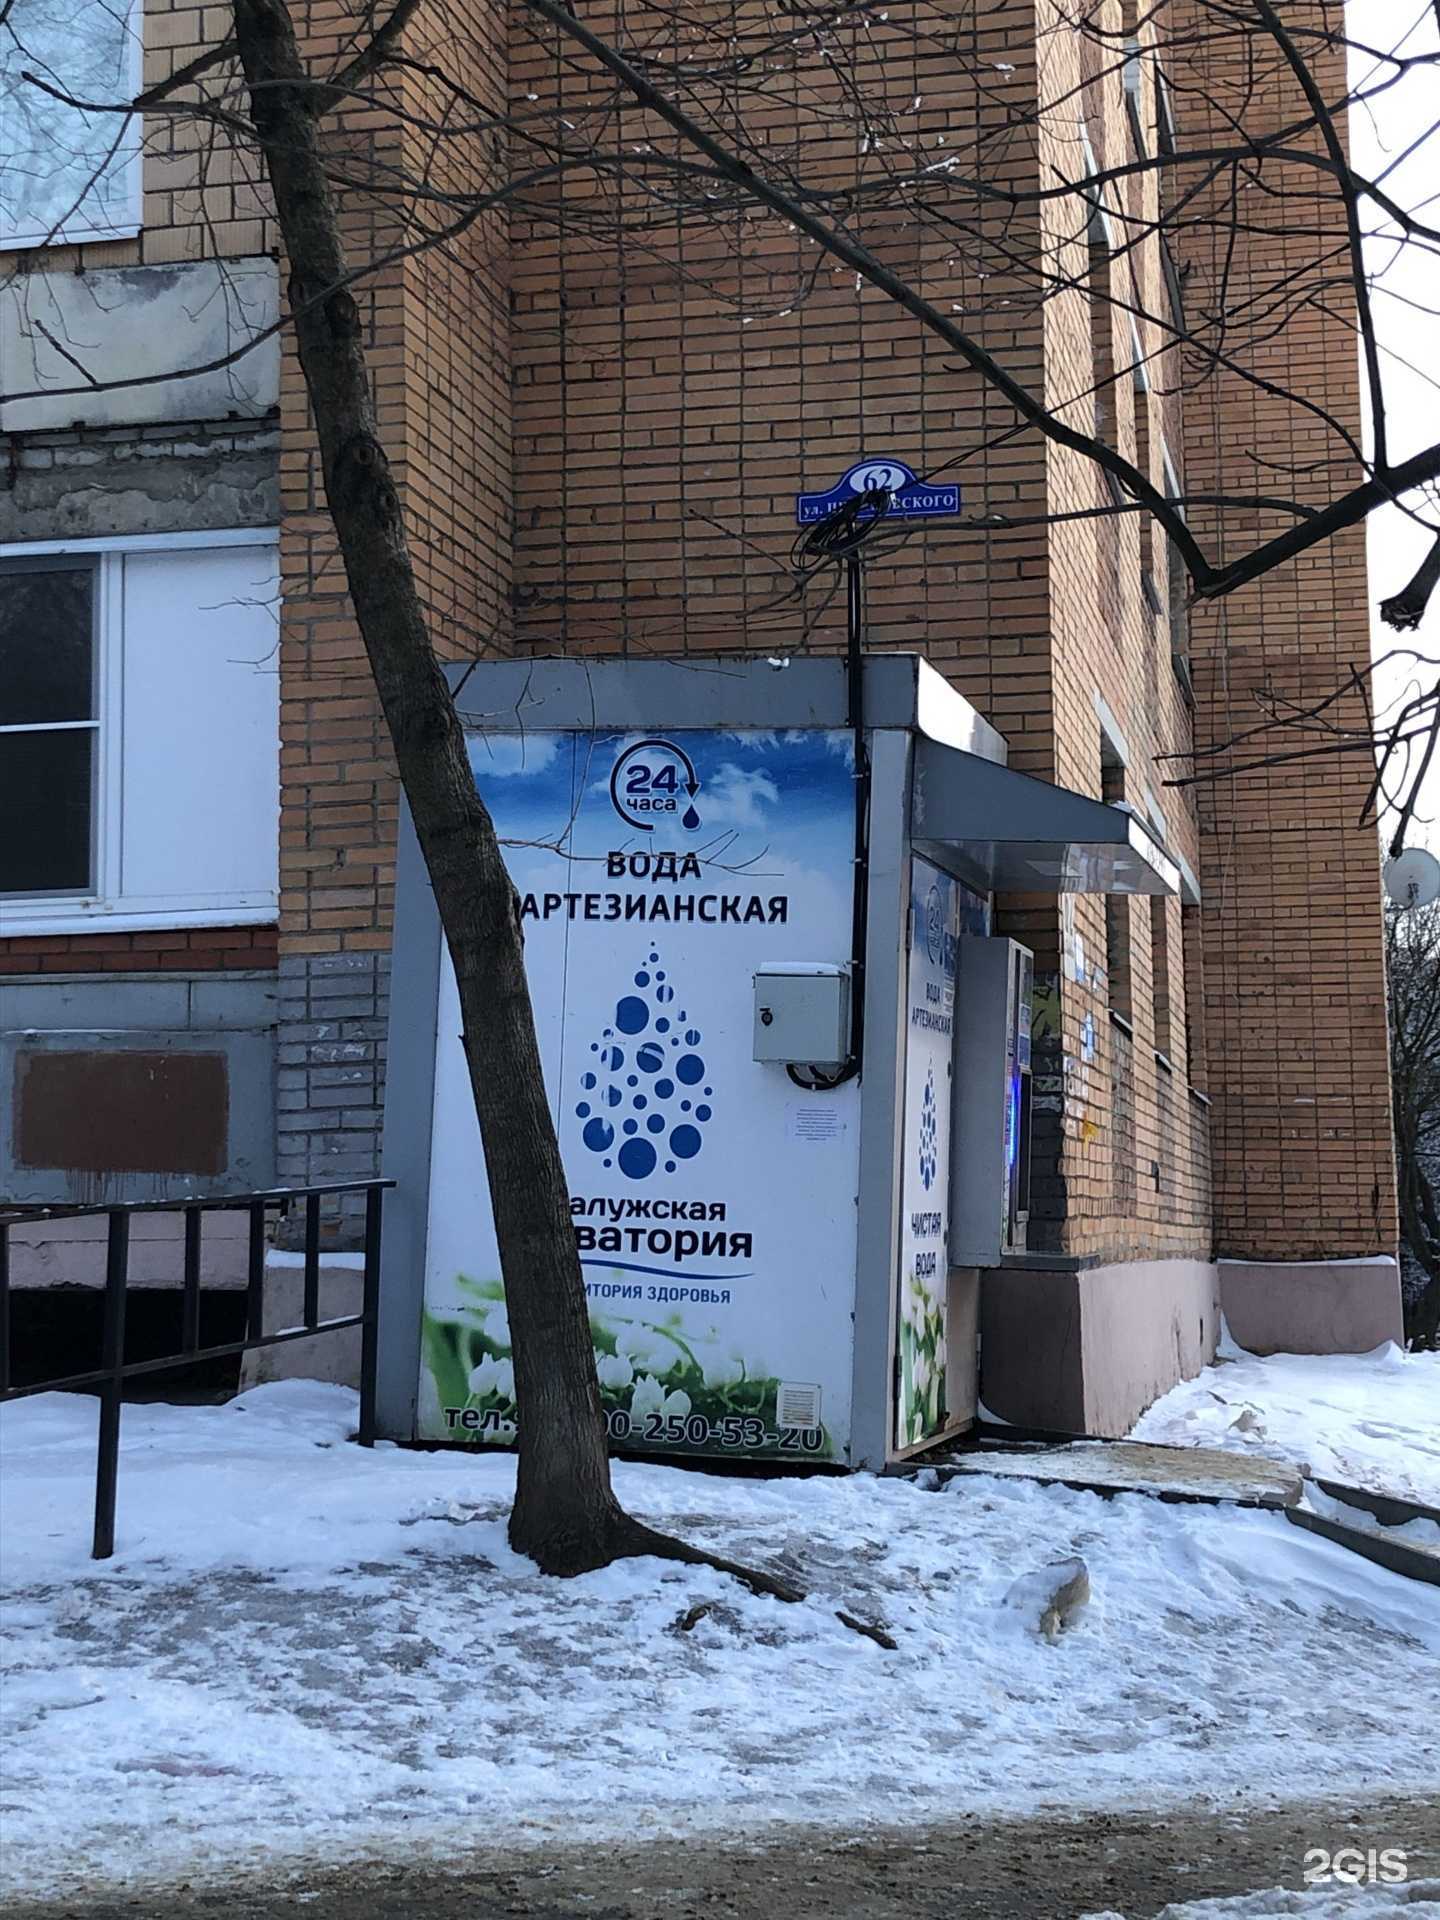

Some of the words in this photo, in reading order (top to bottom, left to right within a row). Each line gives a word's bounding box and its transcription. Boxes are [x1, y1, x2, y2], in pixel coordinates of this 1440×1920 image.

[863, 468, 892, 491] 62
[804, 505, 823, 519] ул.
[626, 765, 678, 795] 24
[627, 797, 677, 812] часа
[607, 851, 702, 883] ВОДА
[520, 893, 788, 923] АРТЕЗИАНСКАЯ
[570, 1196, 727, 1222] алужская
[912, 1212, 942, 1235] ЧИСТАЯ
[916, 1252, 936, 1276] ВОДА
[647, 1285, 731, 1304] ЗДОРОВЬЯ
